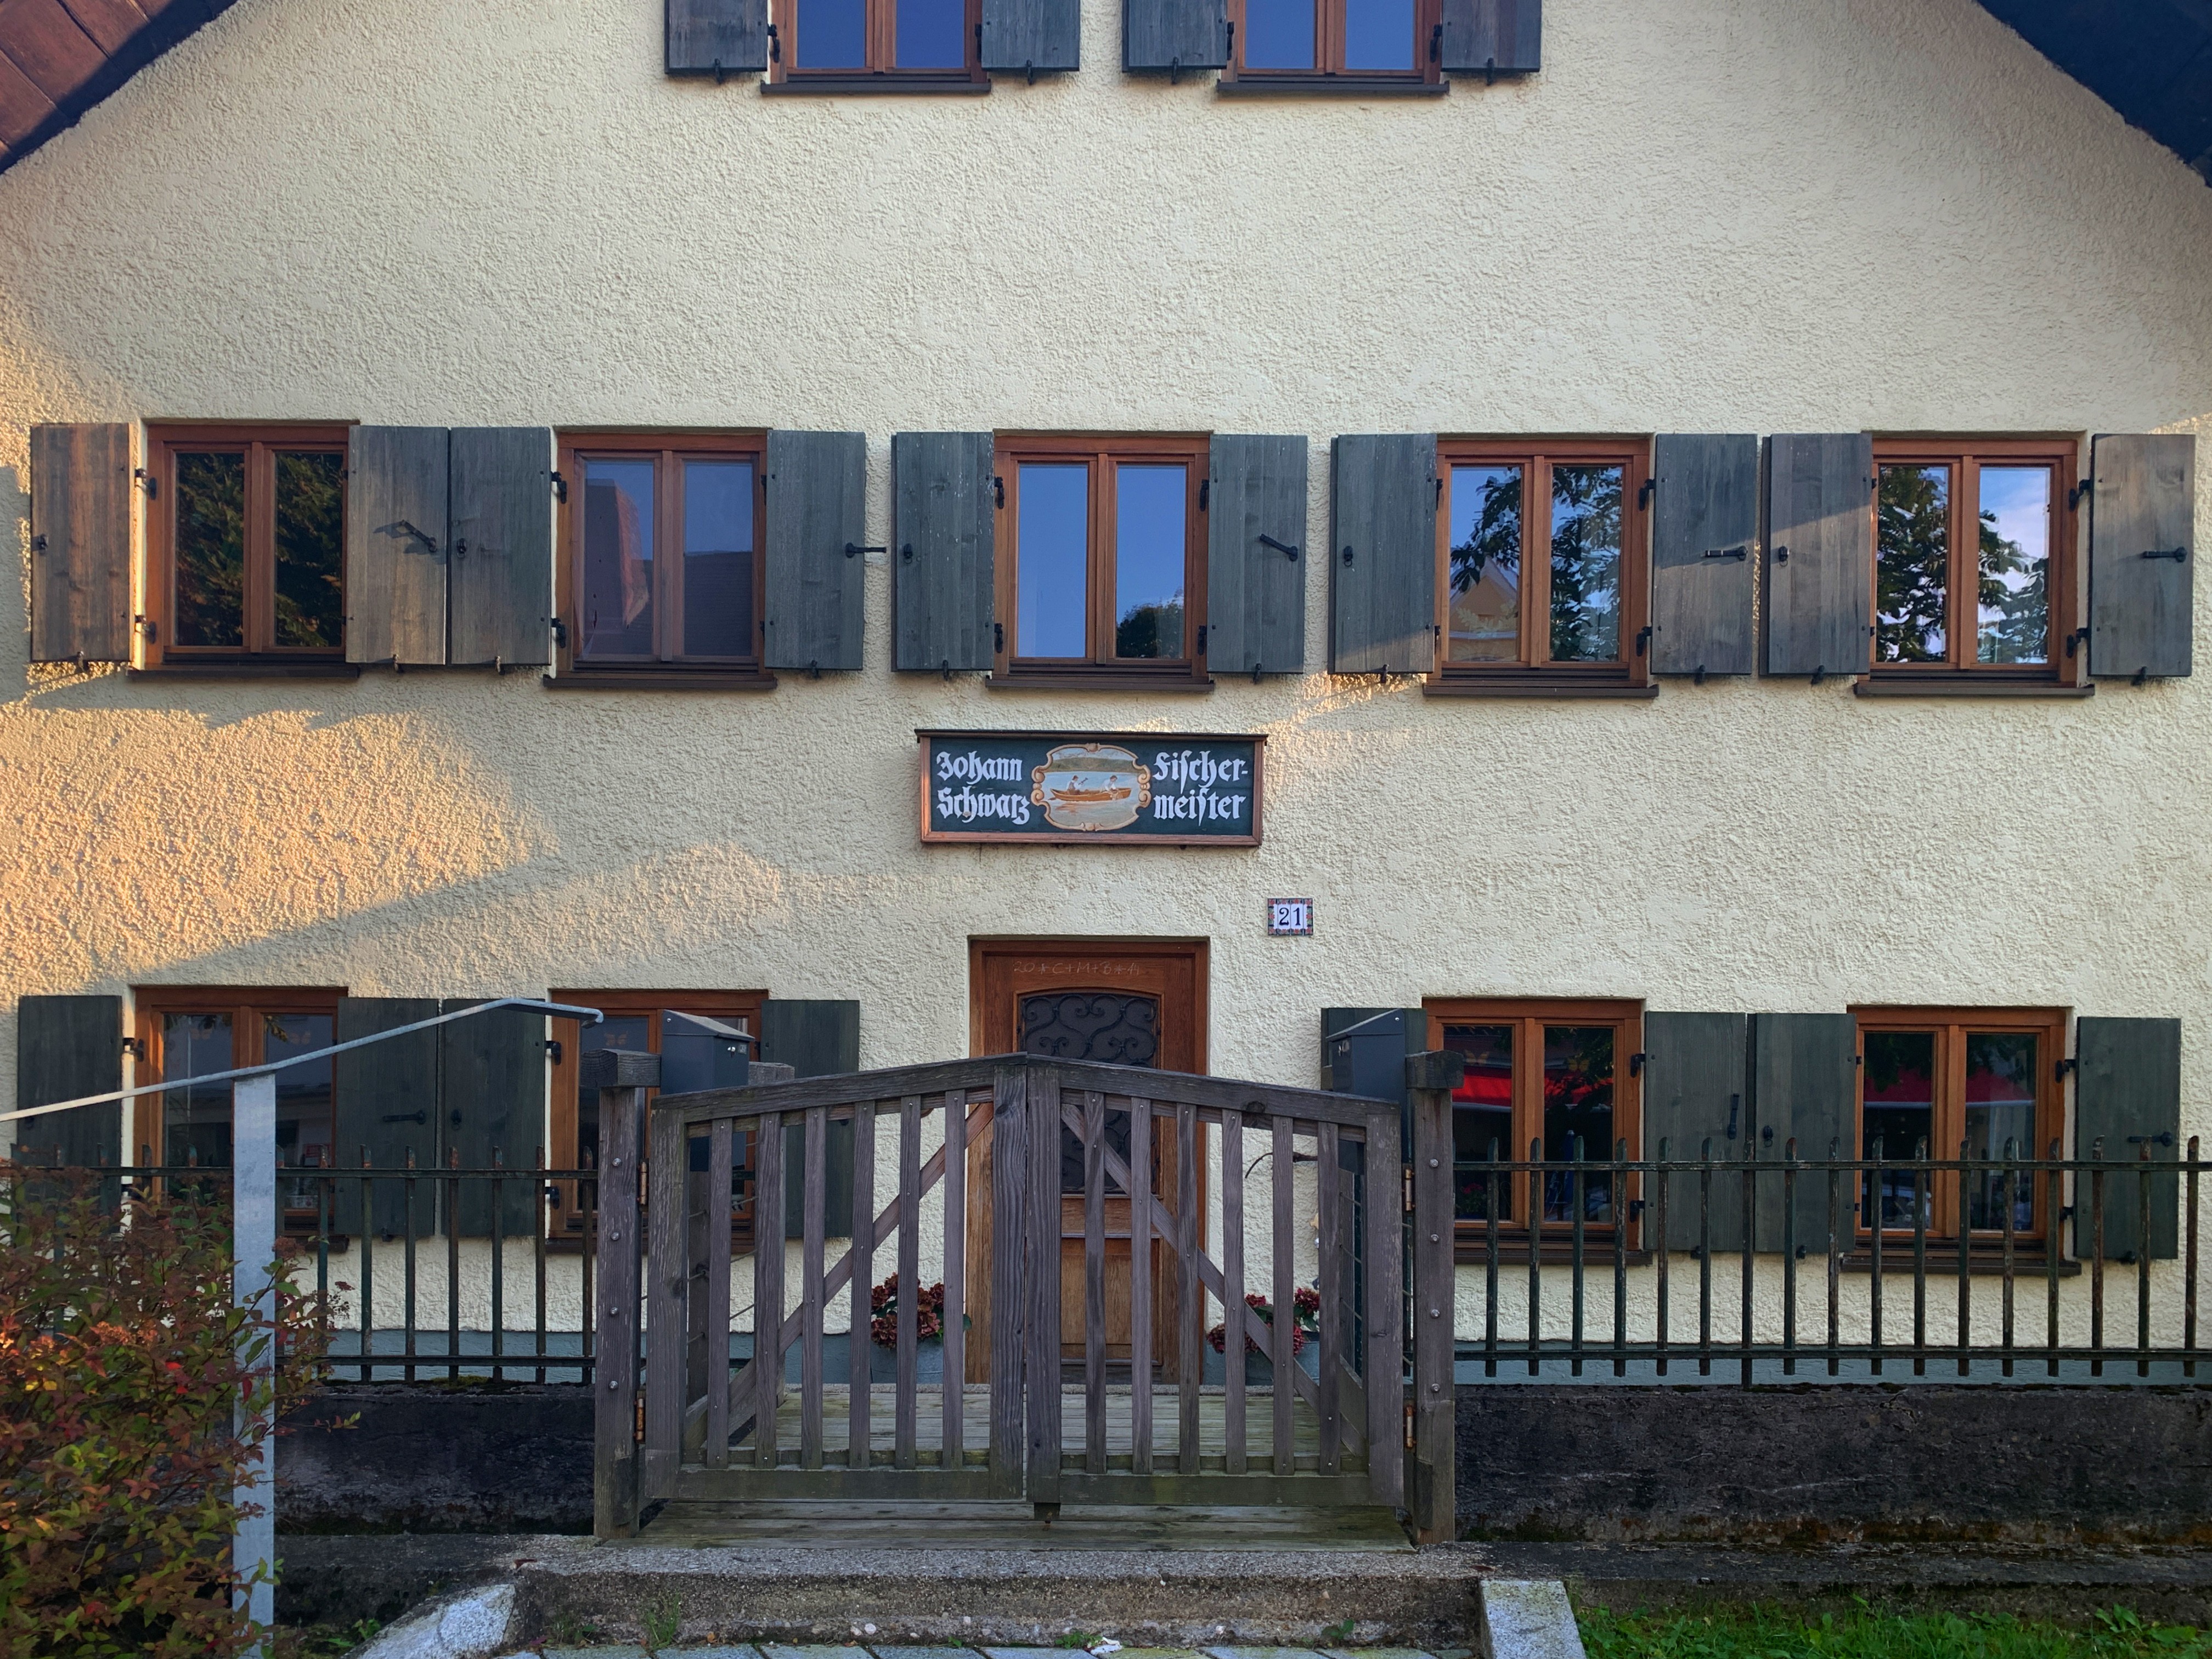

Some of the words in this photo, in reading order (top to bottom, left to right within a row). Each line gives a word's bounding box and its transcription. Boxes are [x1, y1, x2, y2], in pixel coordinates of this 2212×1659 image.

[936, 751, 1023, 785] Johann
[936, 786, 1030, 825] Schwarz
[1279, 907, 1301, 926] 21
